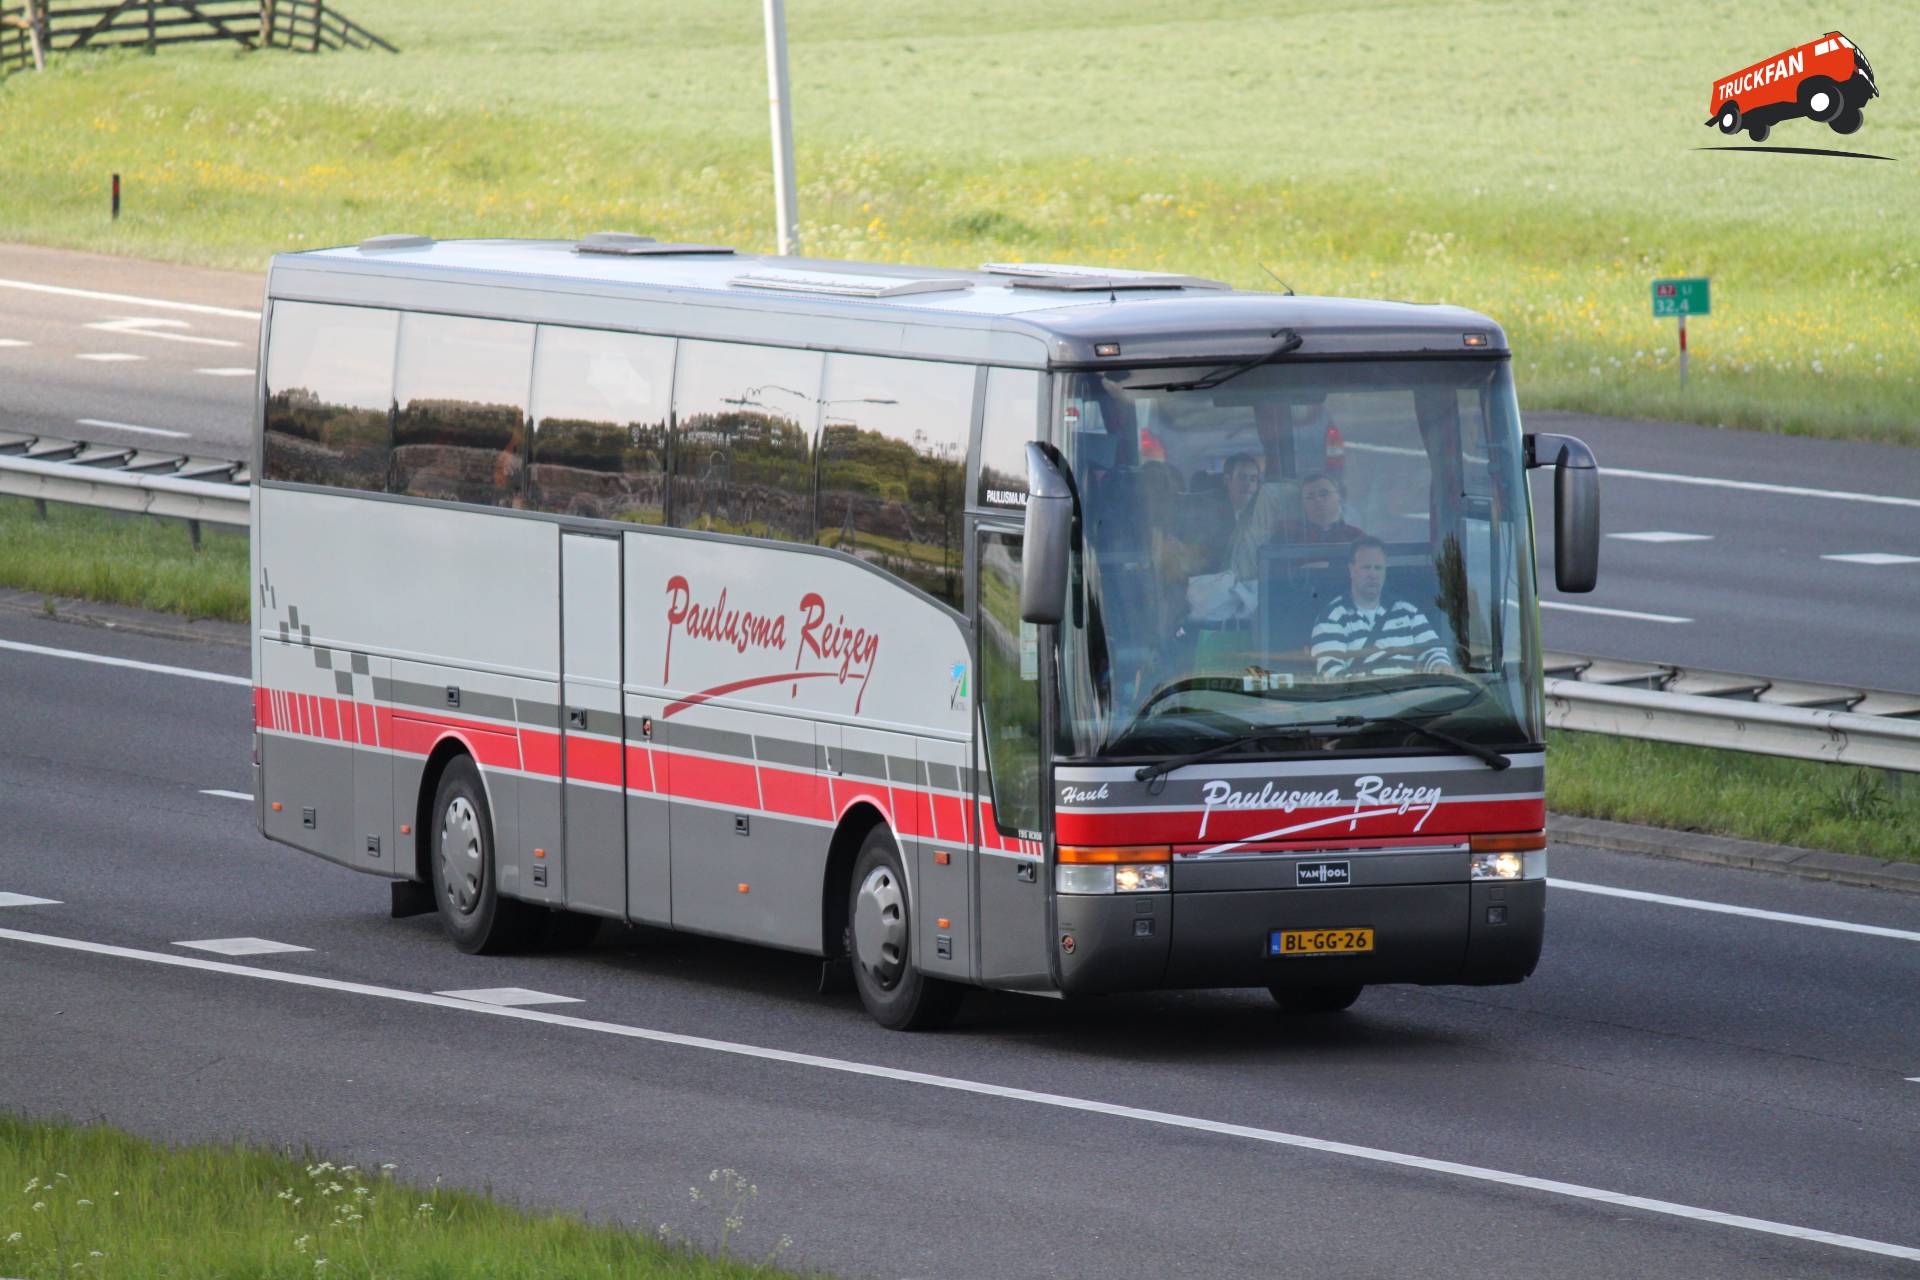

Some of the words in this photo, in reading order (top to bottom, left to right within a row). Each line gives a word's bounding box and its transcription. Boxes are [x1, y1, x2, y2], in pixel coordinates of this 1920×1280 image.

[986, 489, 1026, 506] PAULUSMA.NL
[664, 575, 786, 687] Paulusma
[792, 592, 878, 716] Reizen
[1198, 780, 1341, 840] Paulusma
[1349, 775, 1442, 833] Reizen
[1286, 931, 1367, 950] BL-GG-26
